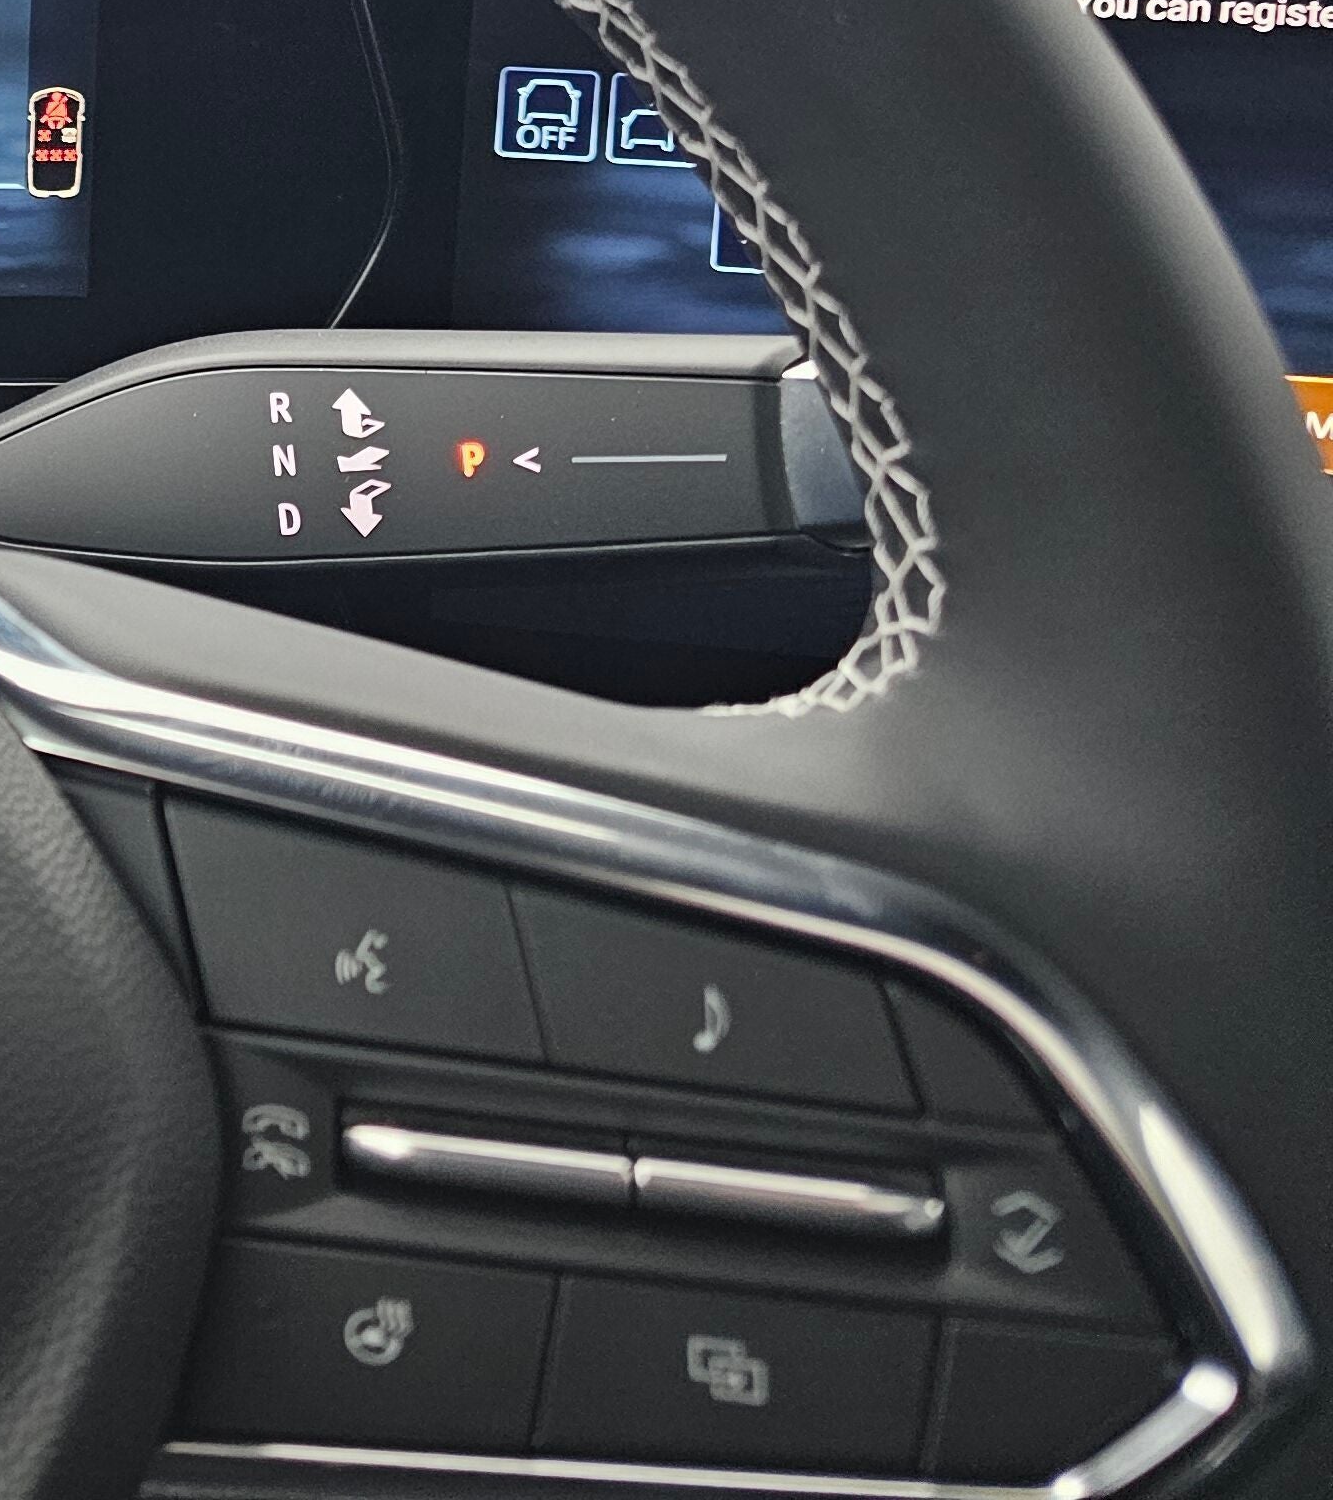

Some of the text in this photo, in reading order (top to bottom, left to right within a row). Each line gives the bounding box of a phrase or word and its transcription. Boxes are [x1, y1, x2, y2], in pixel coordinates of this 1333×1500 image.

[515, 124, 578, 151] OFF
[269, 391, 293, 424] R
[272, 443, 297, 477] N
[460, 441, 485, 478] P
[277, 502, 301, 536] D
